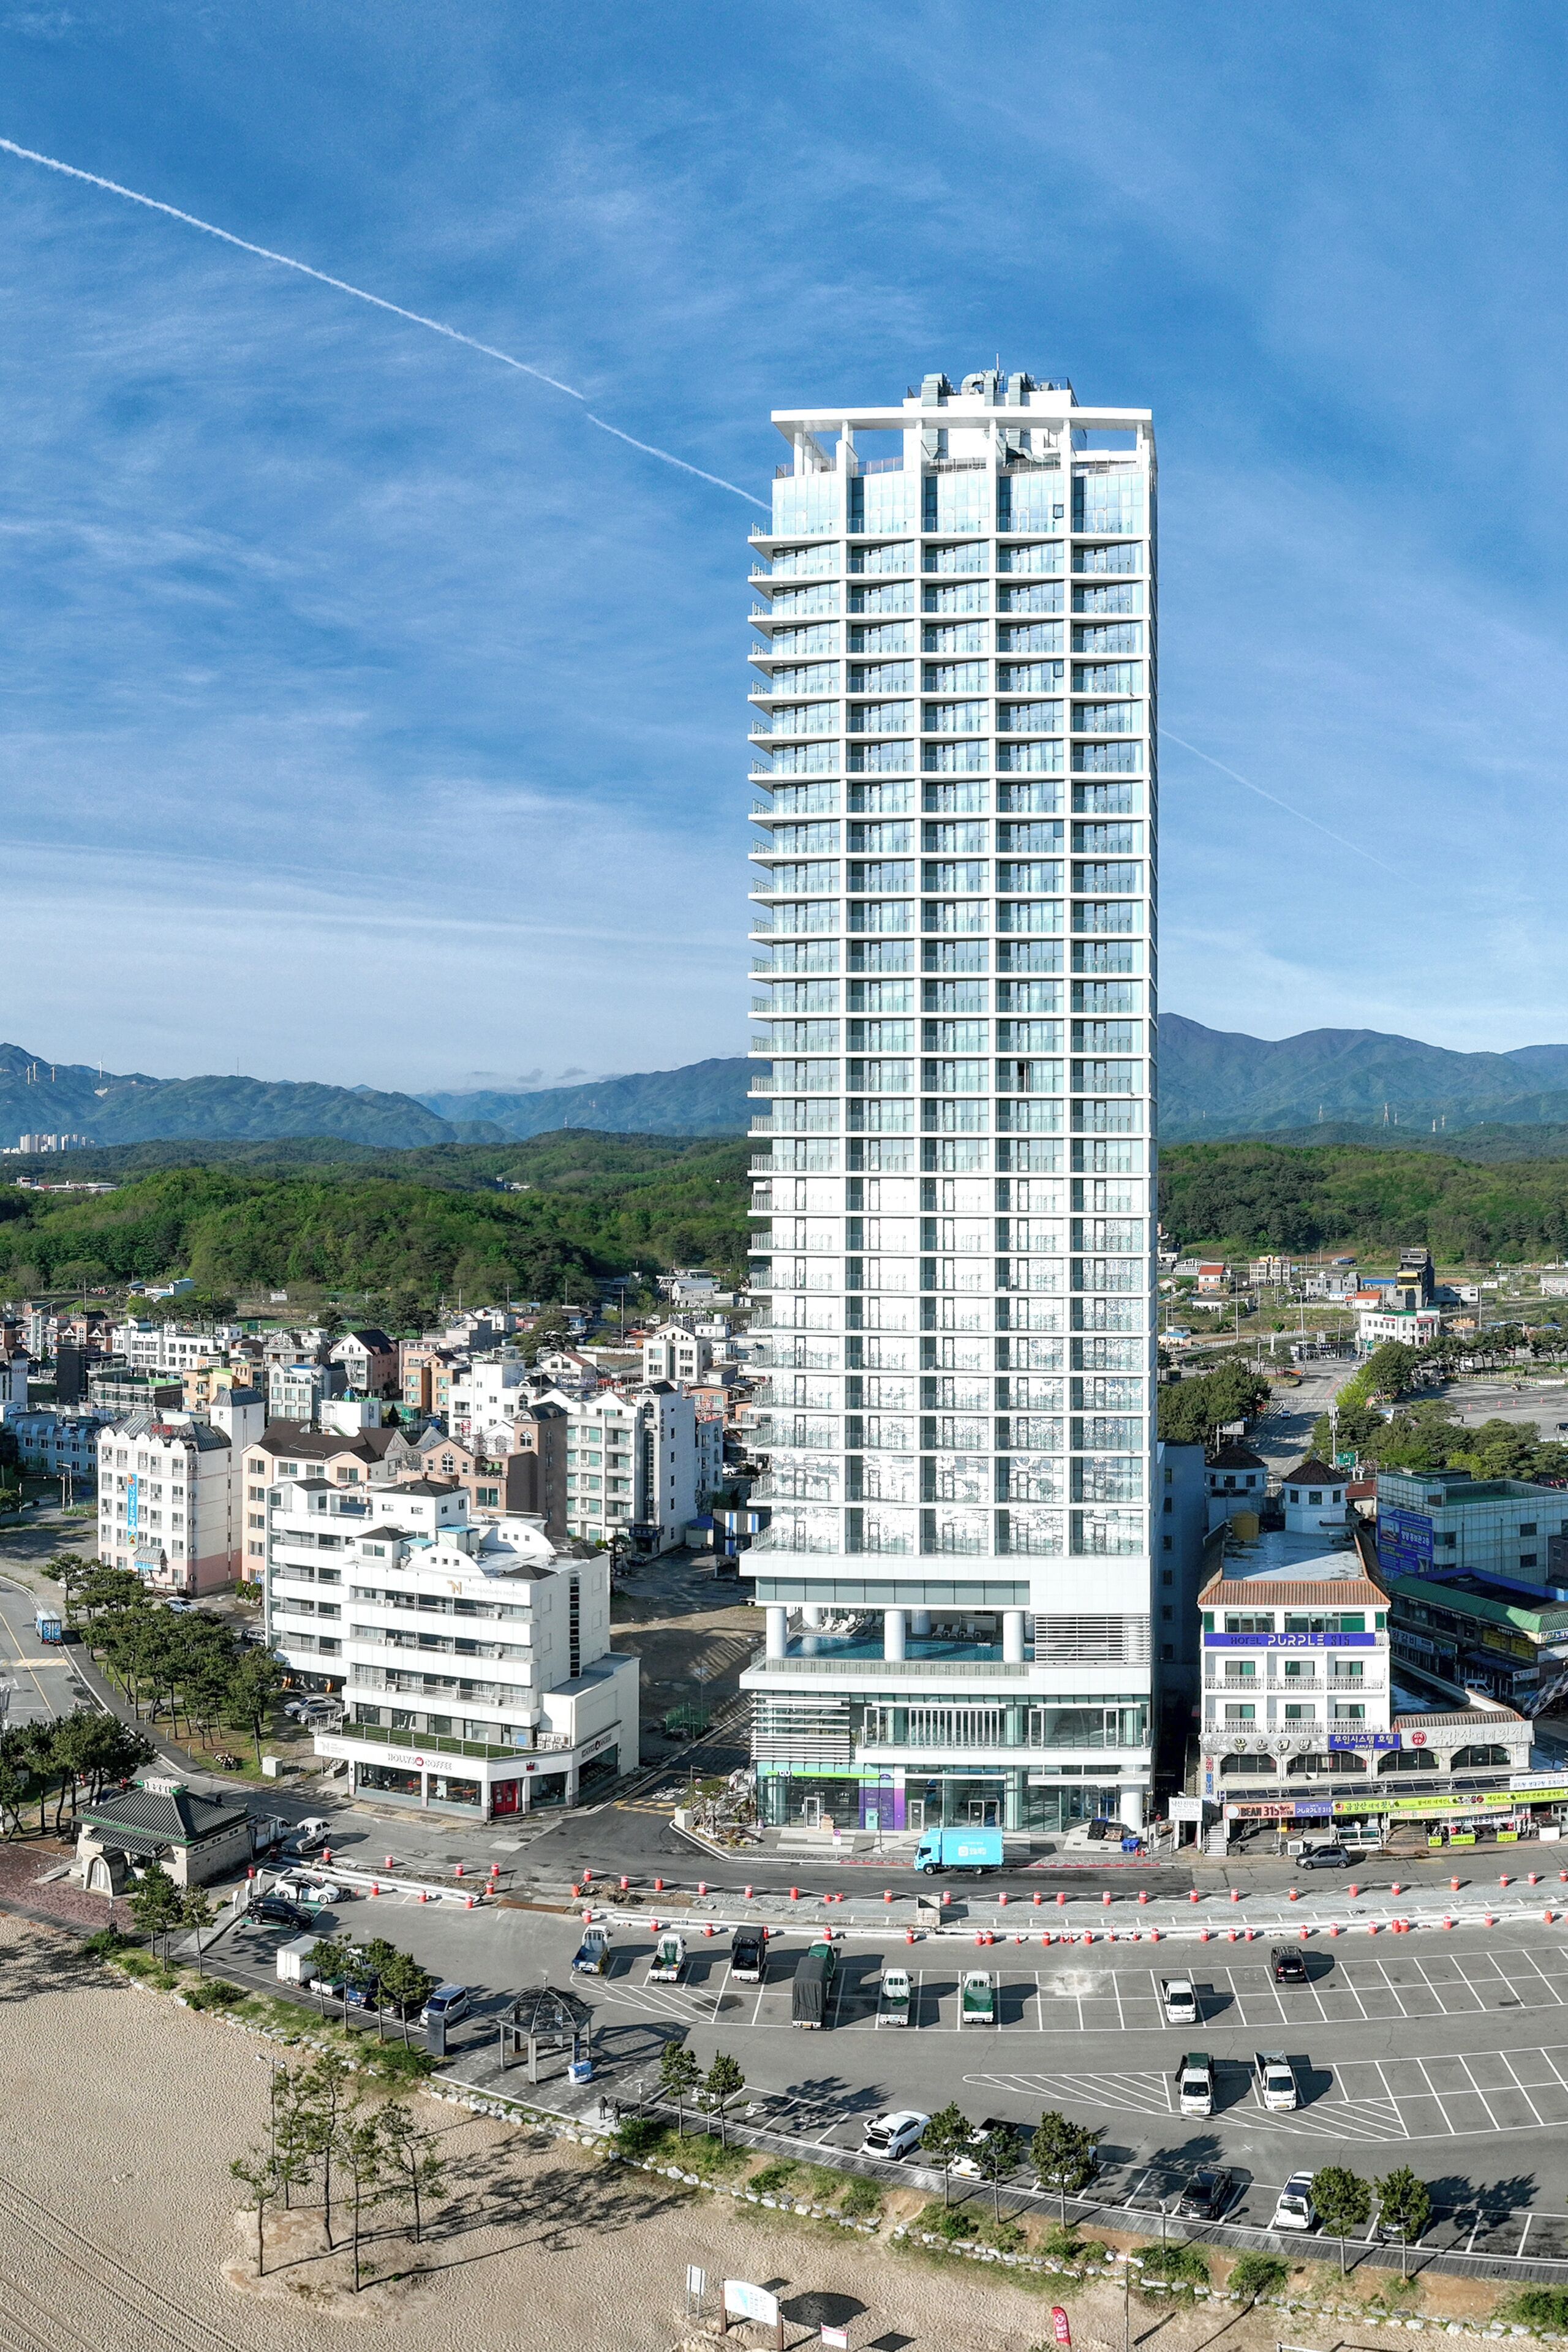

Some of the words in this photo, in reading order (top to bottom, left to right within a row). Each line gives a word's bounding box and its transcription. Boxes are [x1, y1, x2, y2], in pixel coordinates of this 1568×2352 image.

[1231, 1637, 1262, 1645] HOTEL
[1267, 1635, 1325, 1646] PURPLE
[1330, 1635, 1351, 1646] 315
[1333, 1735, 1375, 1744] 무인시스템
[1378, 1733, 1394, 1744] 호텔
[1431, 1728, 1473, 1746] 금강산
[1498, 1725, 1524, 1741] 횟집
[387, 1753, 415, 1764] HOLLYS
[424, 1760, 452, 1771] COFFEE
[1346, 1801, 1367, 1810] 금강산
[1240, 1807, 1262, 1817] BEAN
[1264, 1806, 1279, 1816] 315
